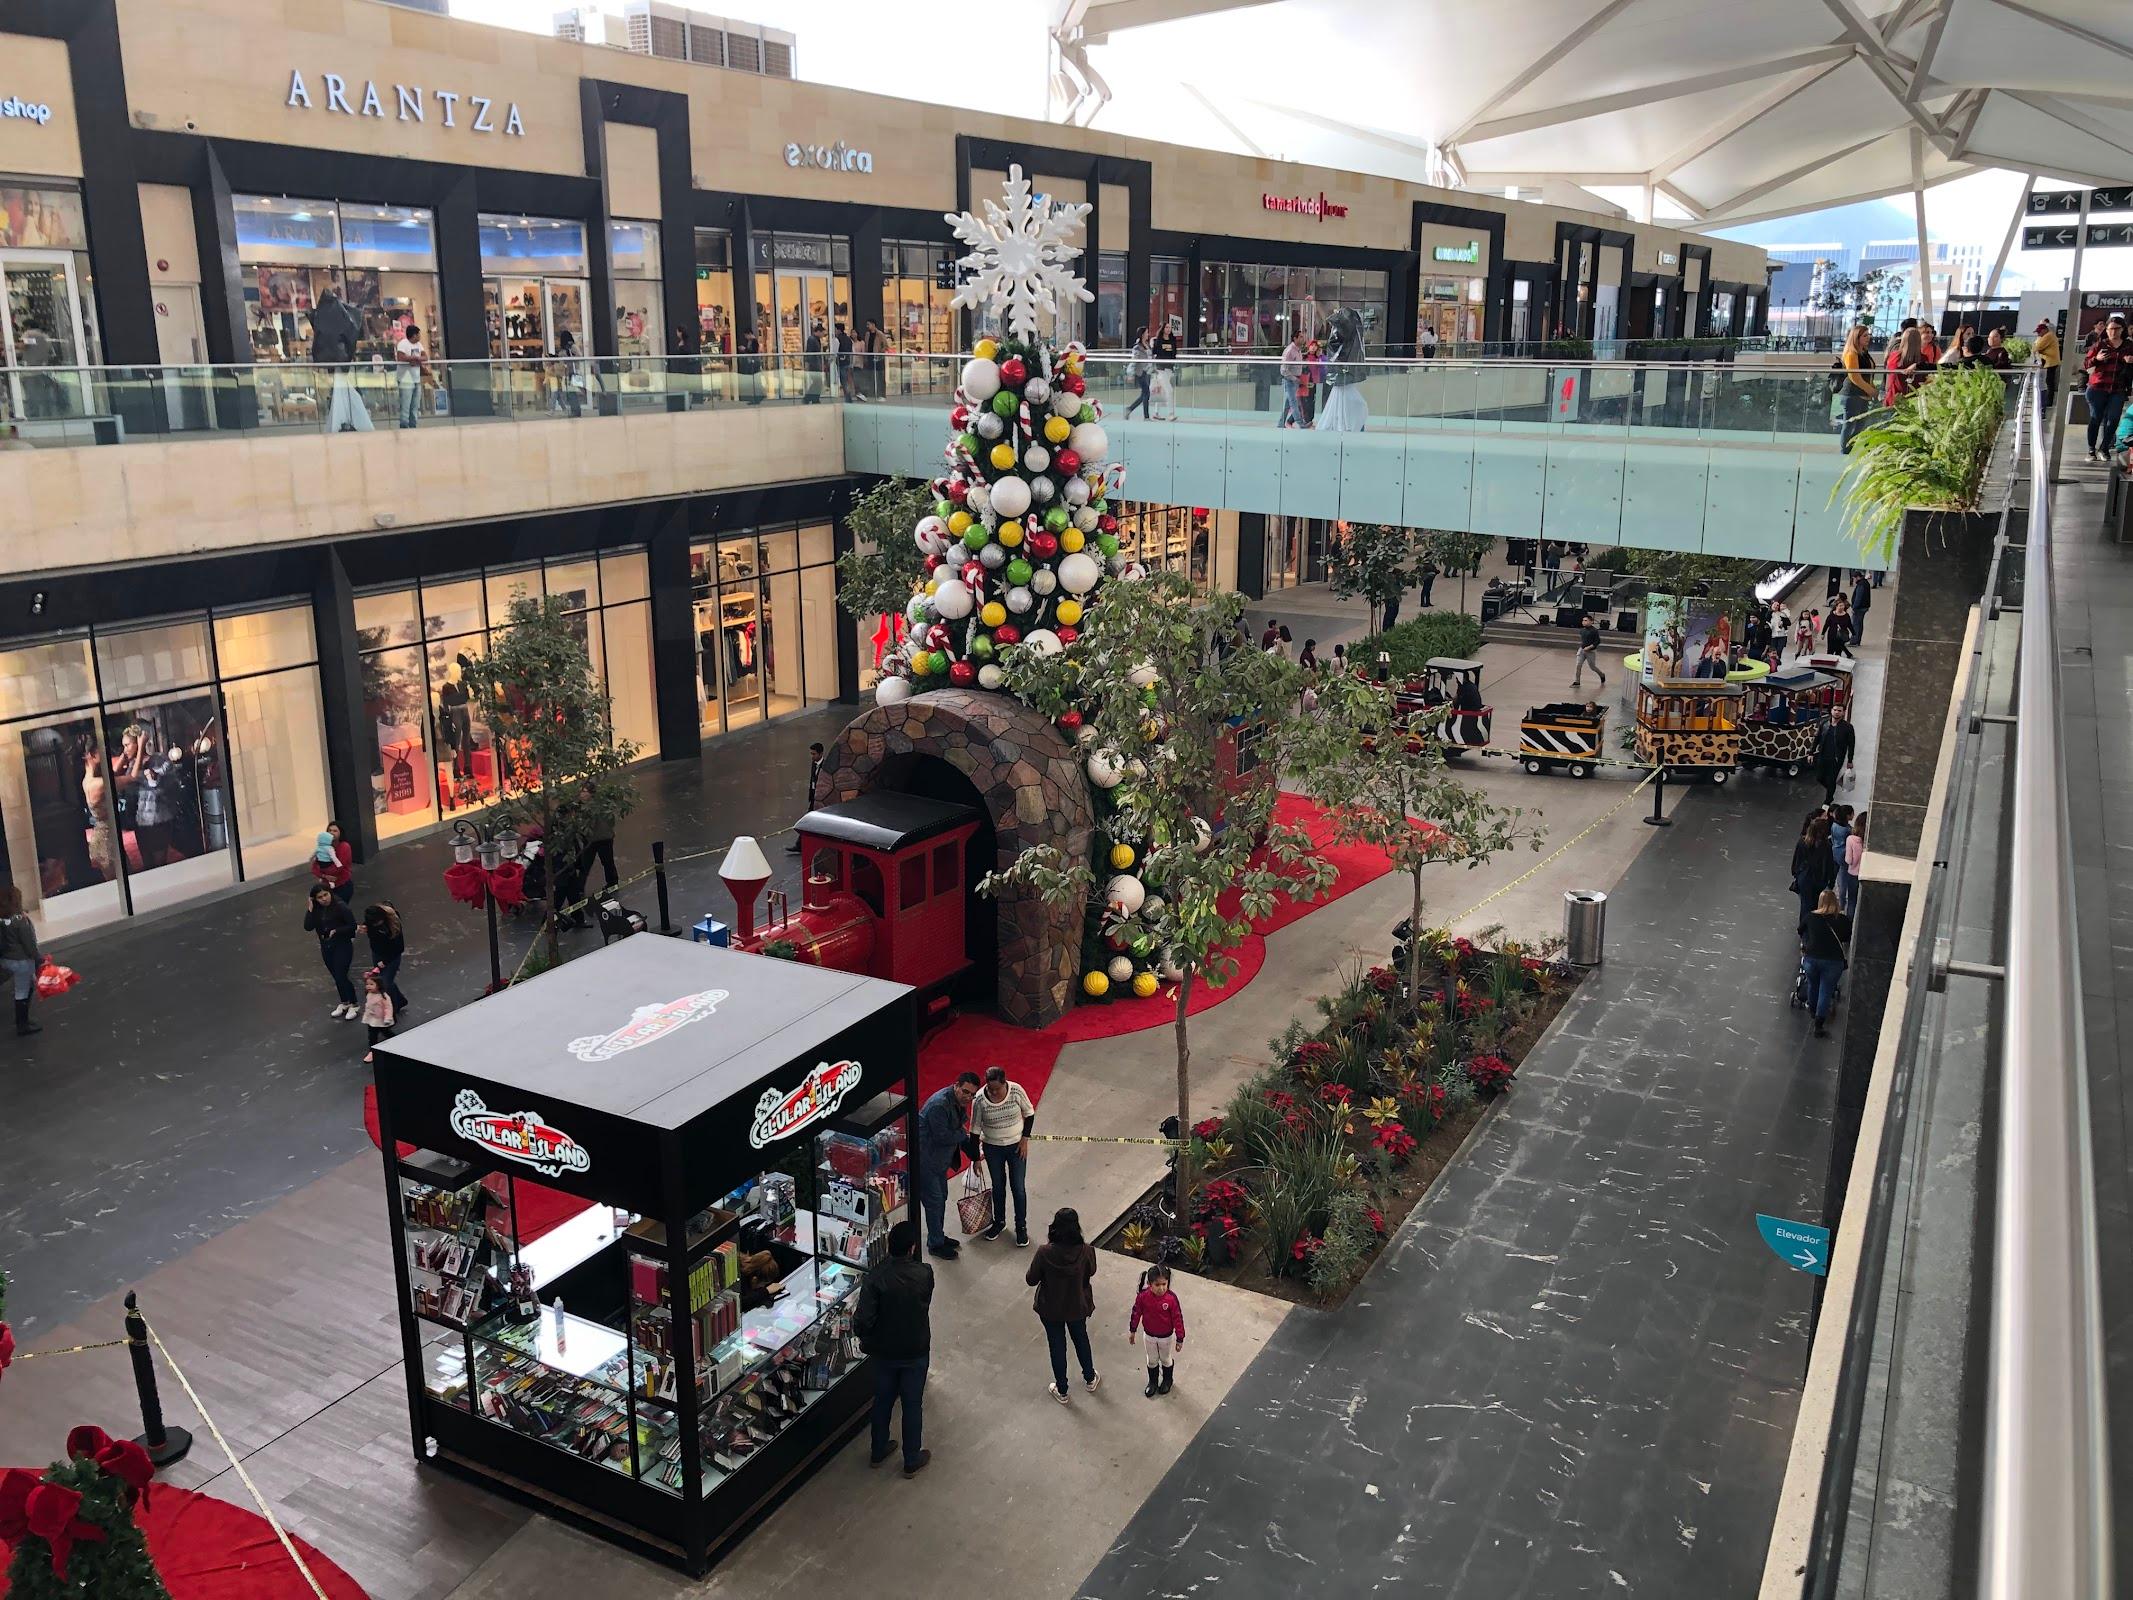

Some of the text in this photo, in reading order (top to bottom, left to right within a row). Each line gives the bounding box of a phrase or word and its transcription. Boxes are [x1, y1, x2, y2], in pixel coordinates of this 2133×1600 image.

[0, 95, 51, 126] shop
[286, 68, 526, 137] ARANTZA
[783, 139, 873, 174] exotica
[1263, 194, 1320, 215] tamarindo
[751, 1063, 860, 1145] CELULAR ISLAND
[453, 1110, 588, 1168] CELULAR ISLAND
[1776, 1227, 1820, 1245] Elevador
